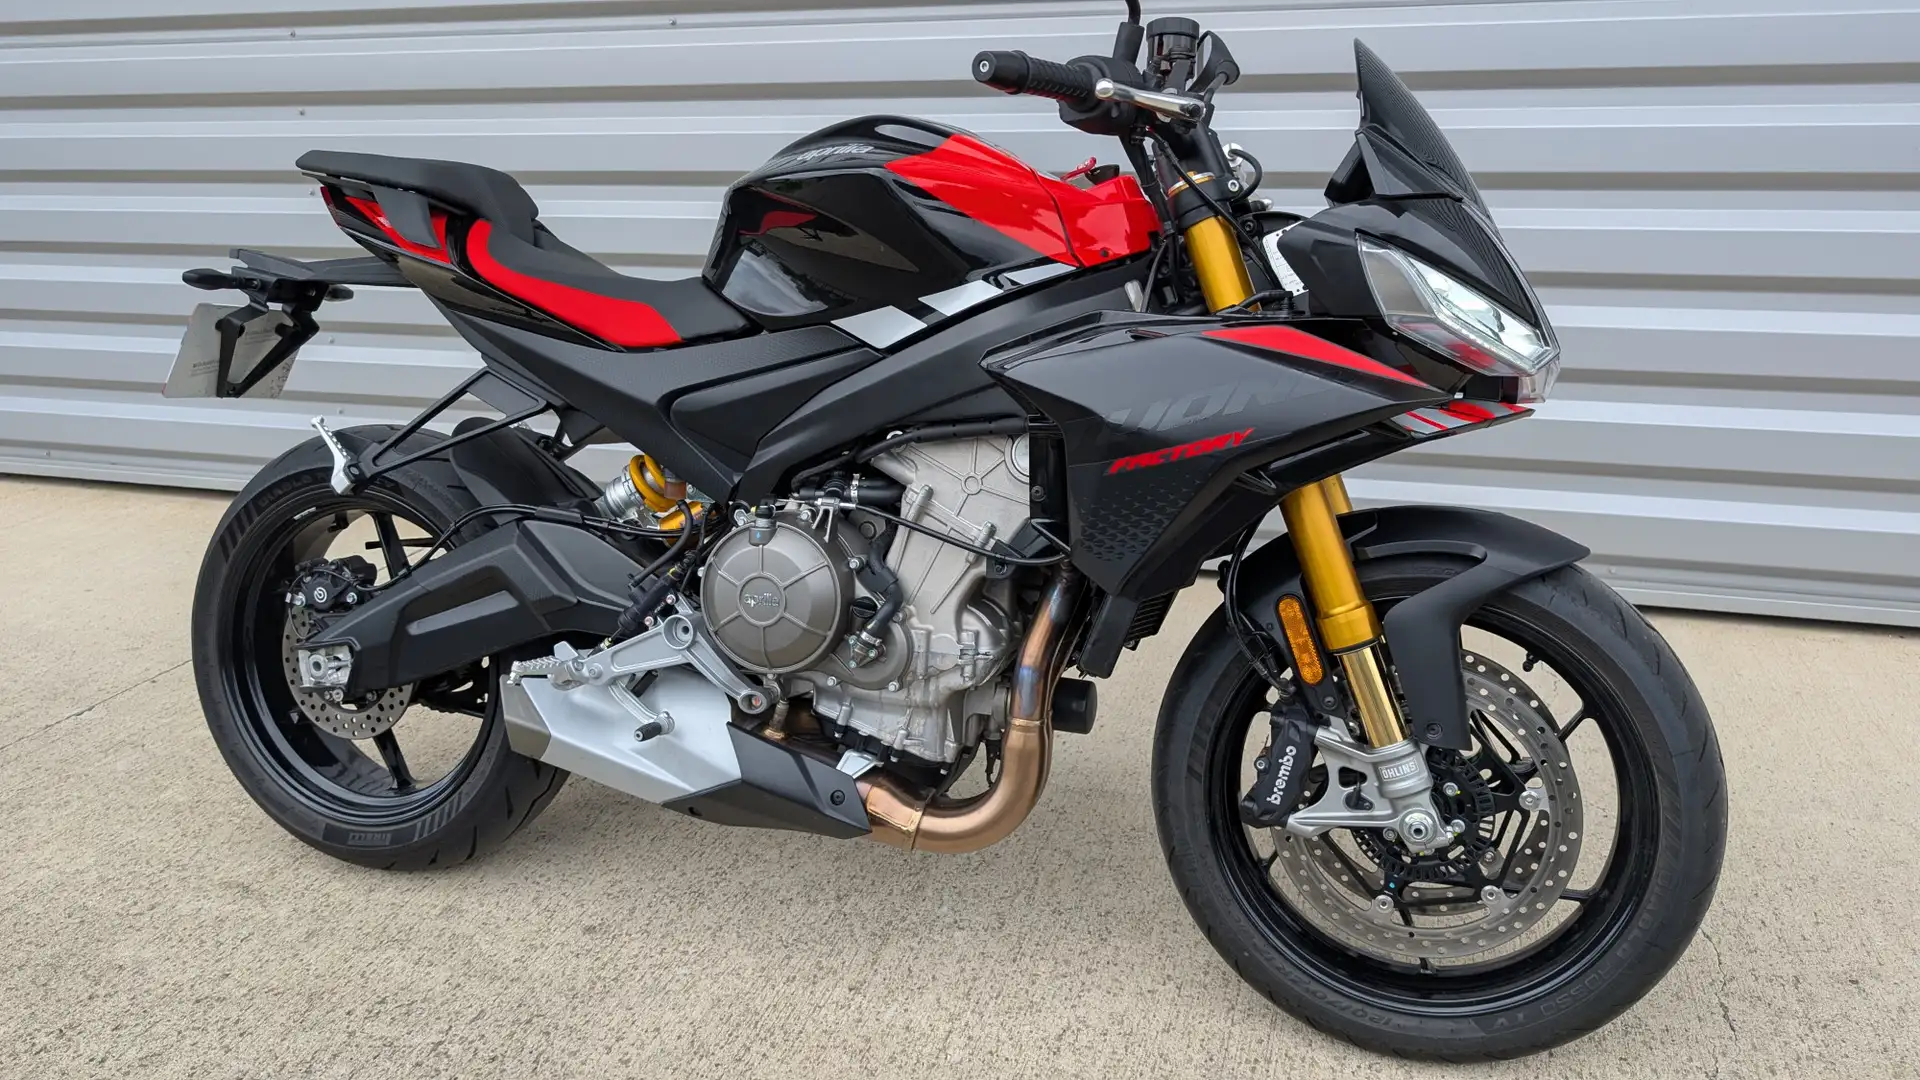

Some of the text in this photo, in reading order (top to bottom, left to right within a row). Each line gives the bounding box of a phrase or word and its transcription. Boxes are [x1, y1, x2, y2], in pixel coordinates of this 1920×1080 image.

[796, 143, 875, 161] aprilia
[1107, 427, 1254, 475] FACTORY
[743, 592, 781, 608] aprilia
[1266, 745, 1297, 805] brembo
[347, 833, 392, 846] PIRELLI
[1539, 961, 1616, 1017] ROSSO
